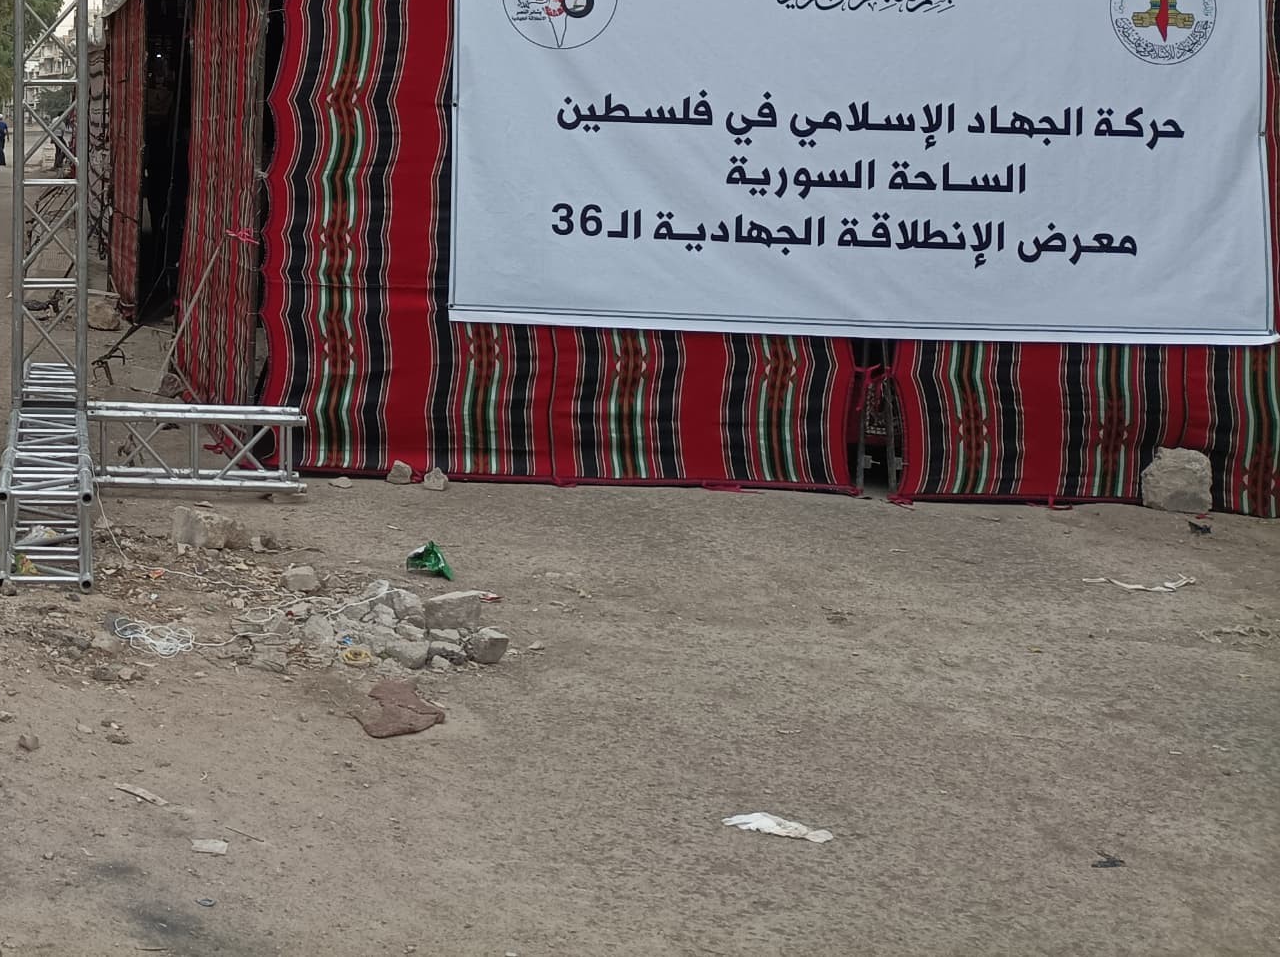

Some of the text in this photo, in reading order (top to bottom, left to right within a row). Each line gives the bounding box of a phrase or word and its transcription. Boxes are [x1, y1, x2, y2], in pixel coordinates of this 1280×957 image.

[556, 89, 1185, 151] حركة الجهاد الإسلامي في فلسطين
[725, 155, 1026, 200] الساحة السورية
[653, 210, 826, 256] الجهادية
[837, 211, 1005, 270] الإنطلاقة
[1017, 222, 1138, 266] معرض
